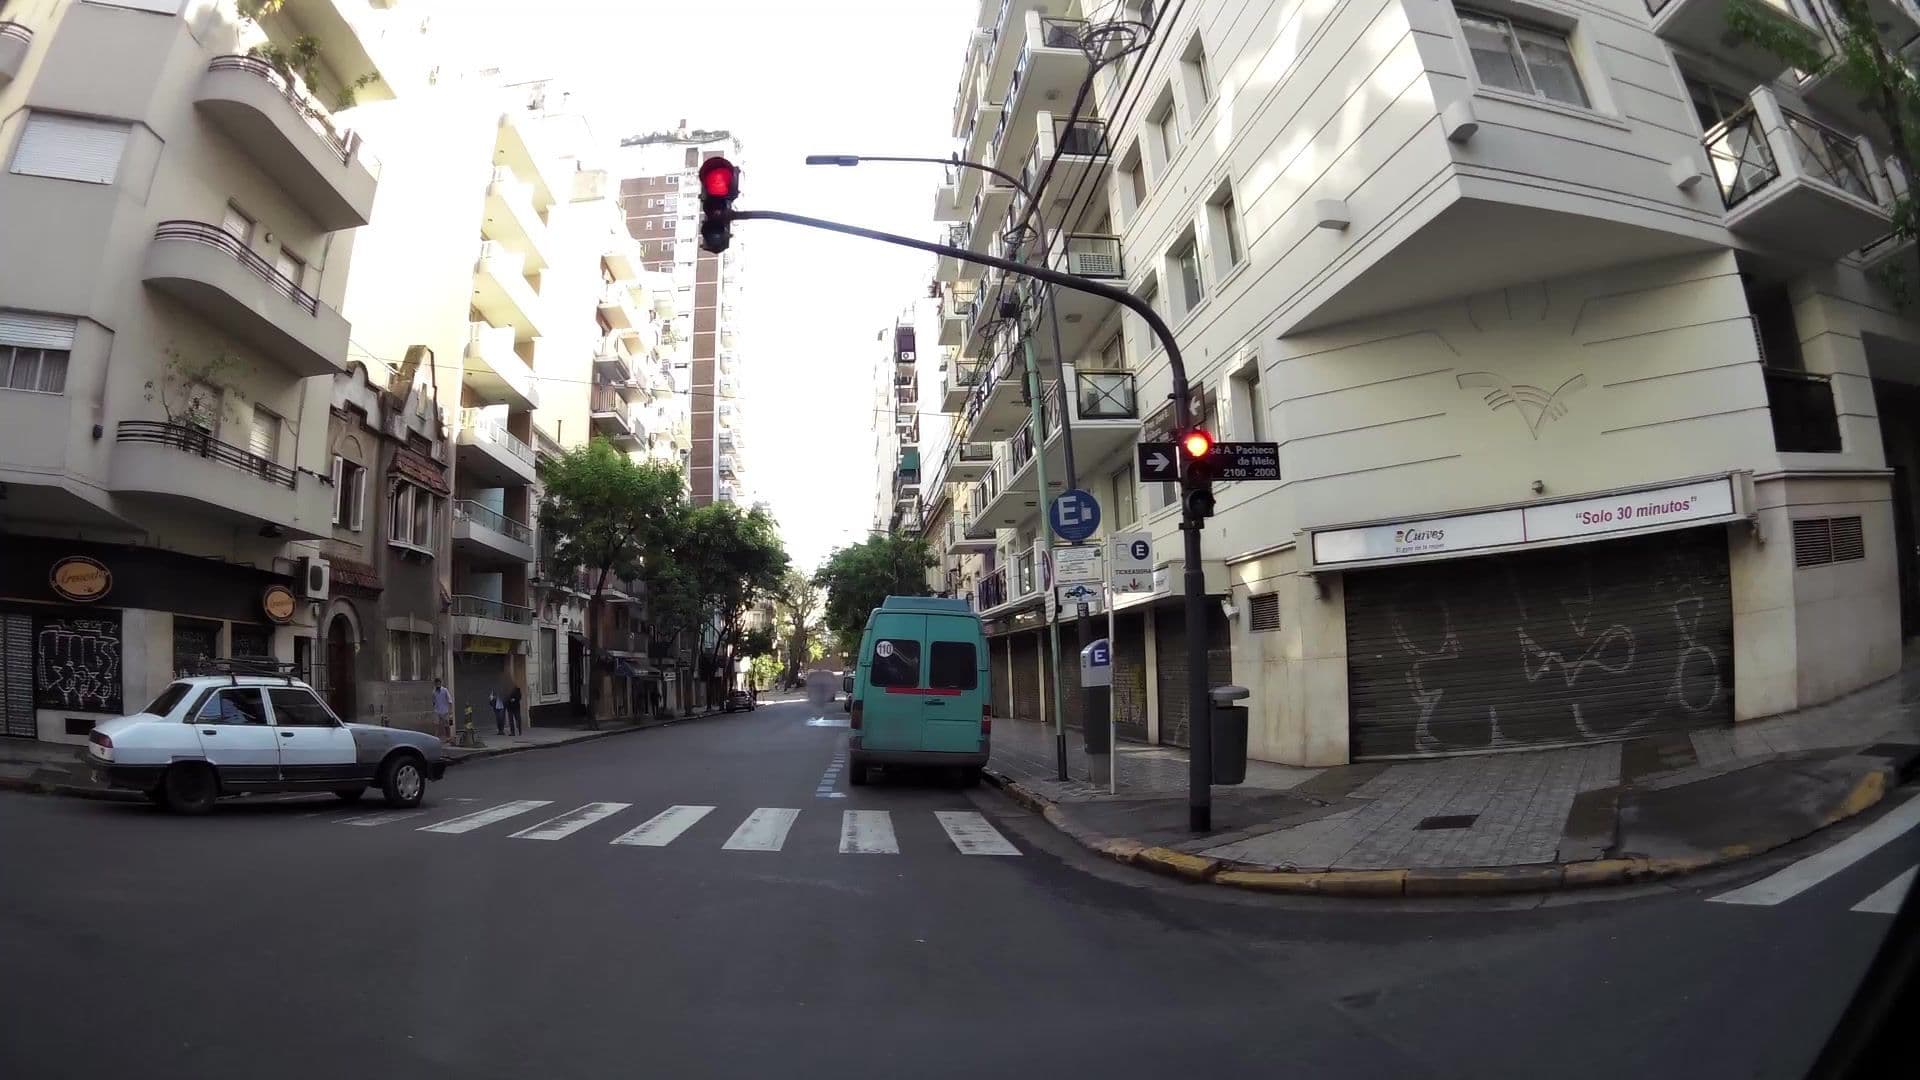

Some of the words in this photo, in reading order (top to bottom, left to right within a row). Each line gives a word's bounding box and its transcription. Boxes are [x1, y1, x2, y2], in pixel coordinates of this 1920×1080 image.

[1224, 446, 1234, 455] A.
[1236, 446, 1275, 455] Pacheco
[1237, 456, 1250, 466] de
[1252, 456, 1276, 466] Melo
[1223, 468, 1247, 477] 2100
[1254, 468, 1277, 477] 2000
[1058, 496, 1079, 526] E
[1616, 506, 1632, 520] 30
[1405, 528, 1445, 543] Curves
[1136, 544, 1145, 556] E
[879, 644, 892, 655] 110
[1094, 649, 1106, 662] E
